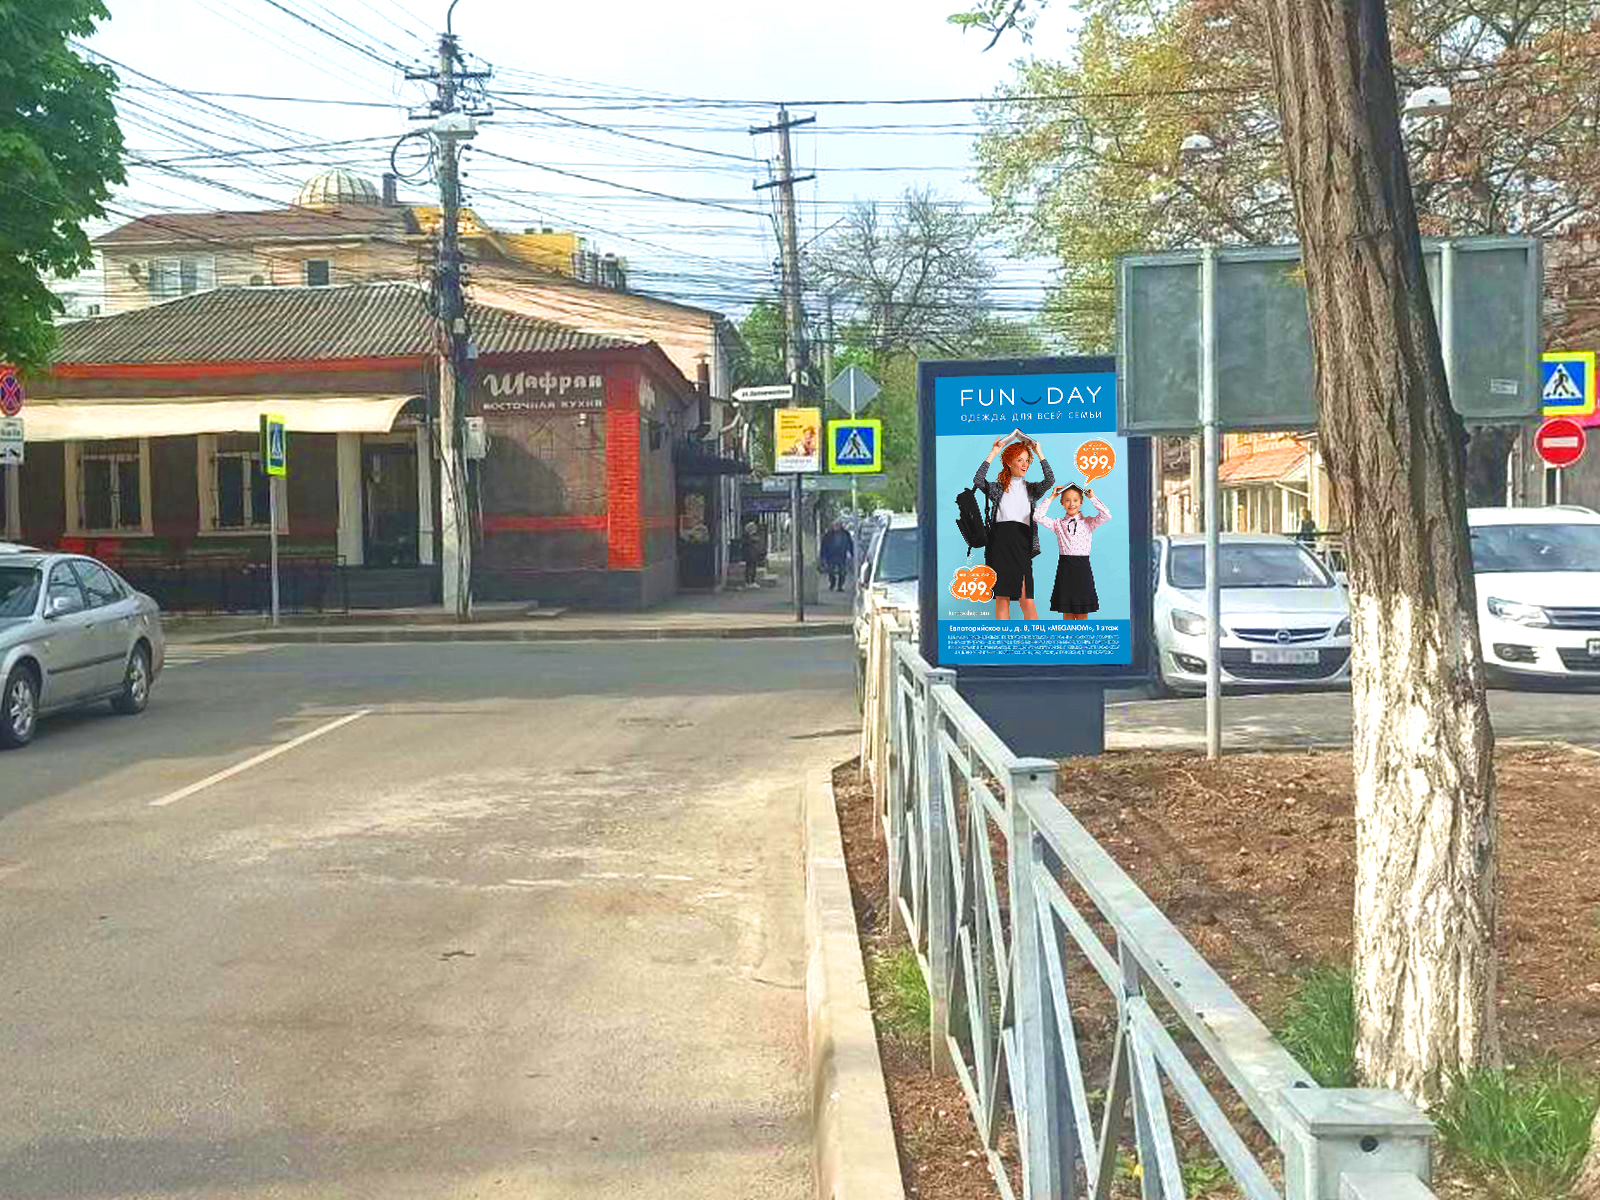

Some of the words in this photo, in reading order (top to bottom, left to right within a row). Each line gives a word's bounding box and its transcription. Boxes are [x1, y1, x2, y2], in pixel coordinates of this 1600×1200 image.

[483, 371, 602, 397] Шафран
[960, 388, 1015, 407] FUN
[1047, 385, 1102, 405] DAY
[483, 401, 556, 410] ВОСТОЧНАЯ
[561, 399, 602, 408] КУХНЯ
[960, 413, 1006, 423] ОДЕЖДА
[1011, 412, 1033, 422] ДЛЯ
[1037, 410, 1063, 420] ВСЕЙ
[1067, 410, 1102, 420] СЕМЬИ
[1079, 455, 1112, 470] 399.
[957, 581, 990, 596] 499.
[1031, 624, 1046, 632] ТРЦ
